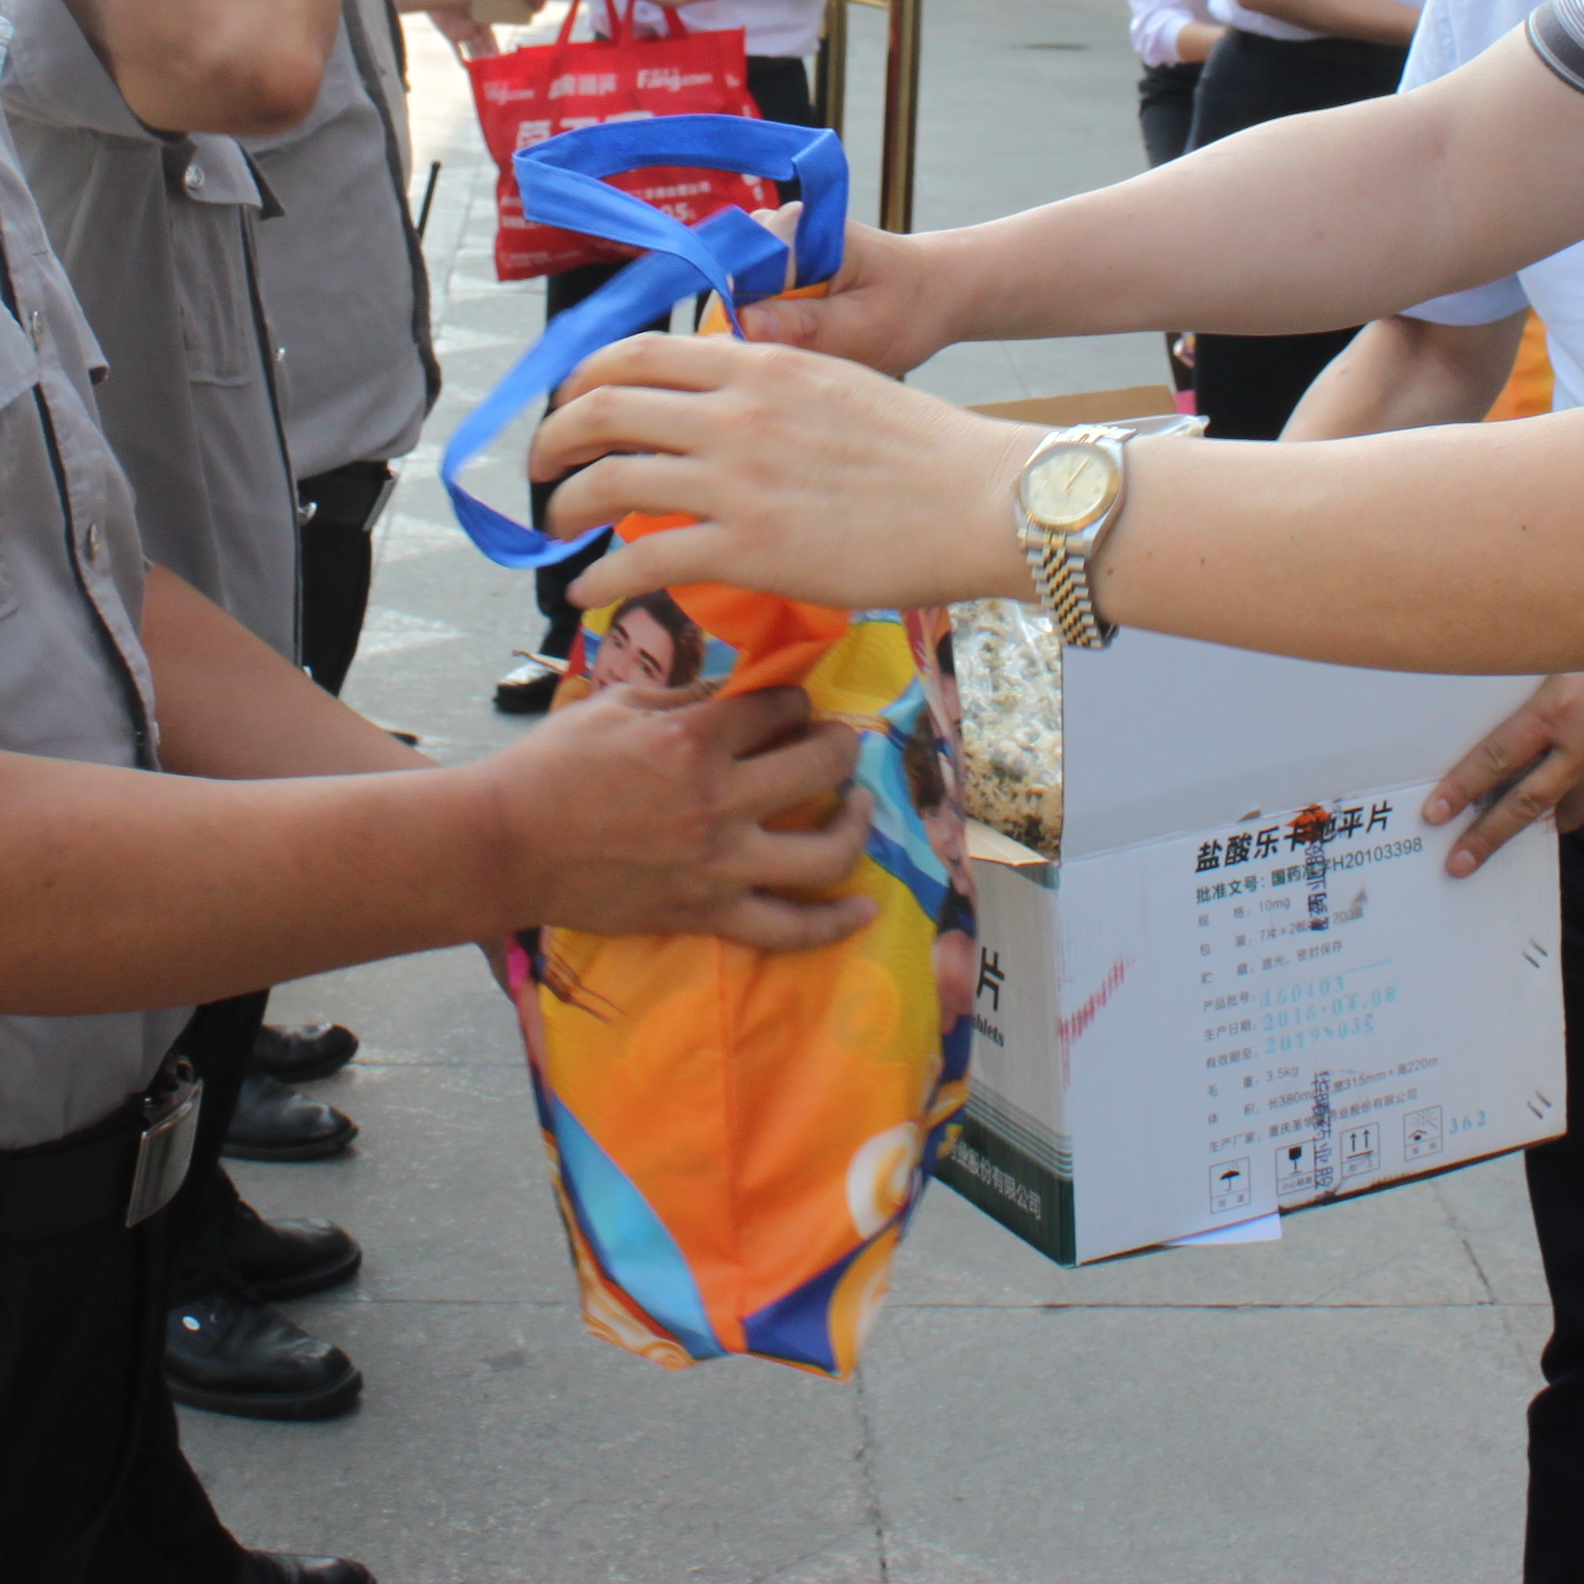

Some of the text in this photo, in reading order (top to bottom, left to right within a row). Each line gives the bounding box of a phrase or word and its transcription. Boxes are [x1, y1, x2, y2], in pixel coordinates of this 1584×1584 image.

[1195, 800, 1393, 873] 盐酸乐卡地平片
[1259, 898, 1290, 913] 10mg
[977, 946, 1005, 1012] 片
[1266, 1066, 1299, 1082] 3.5kg
